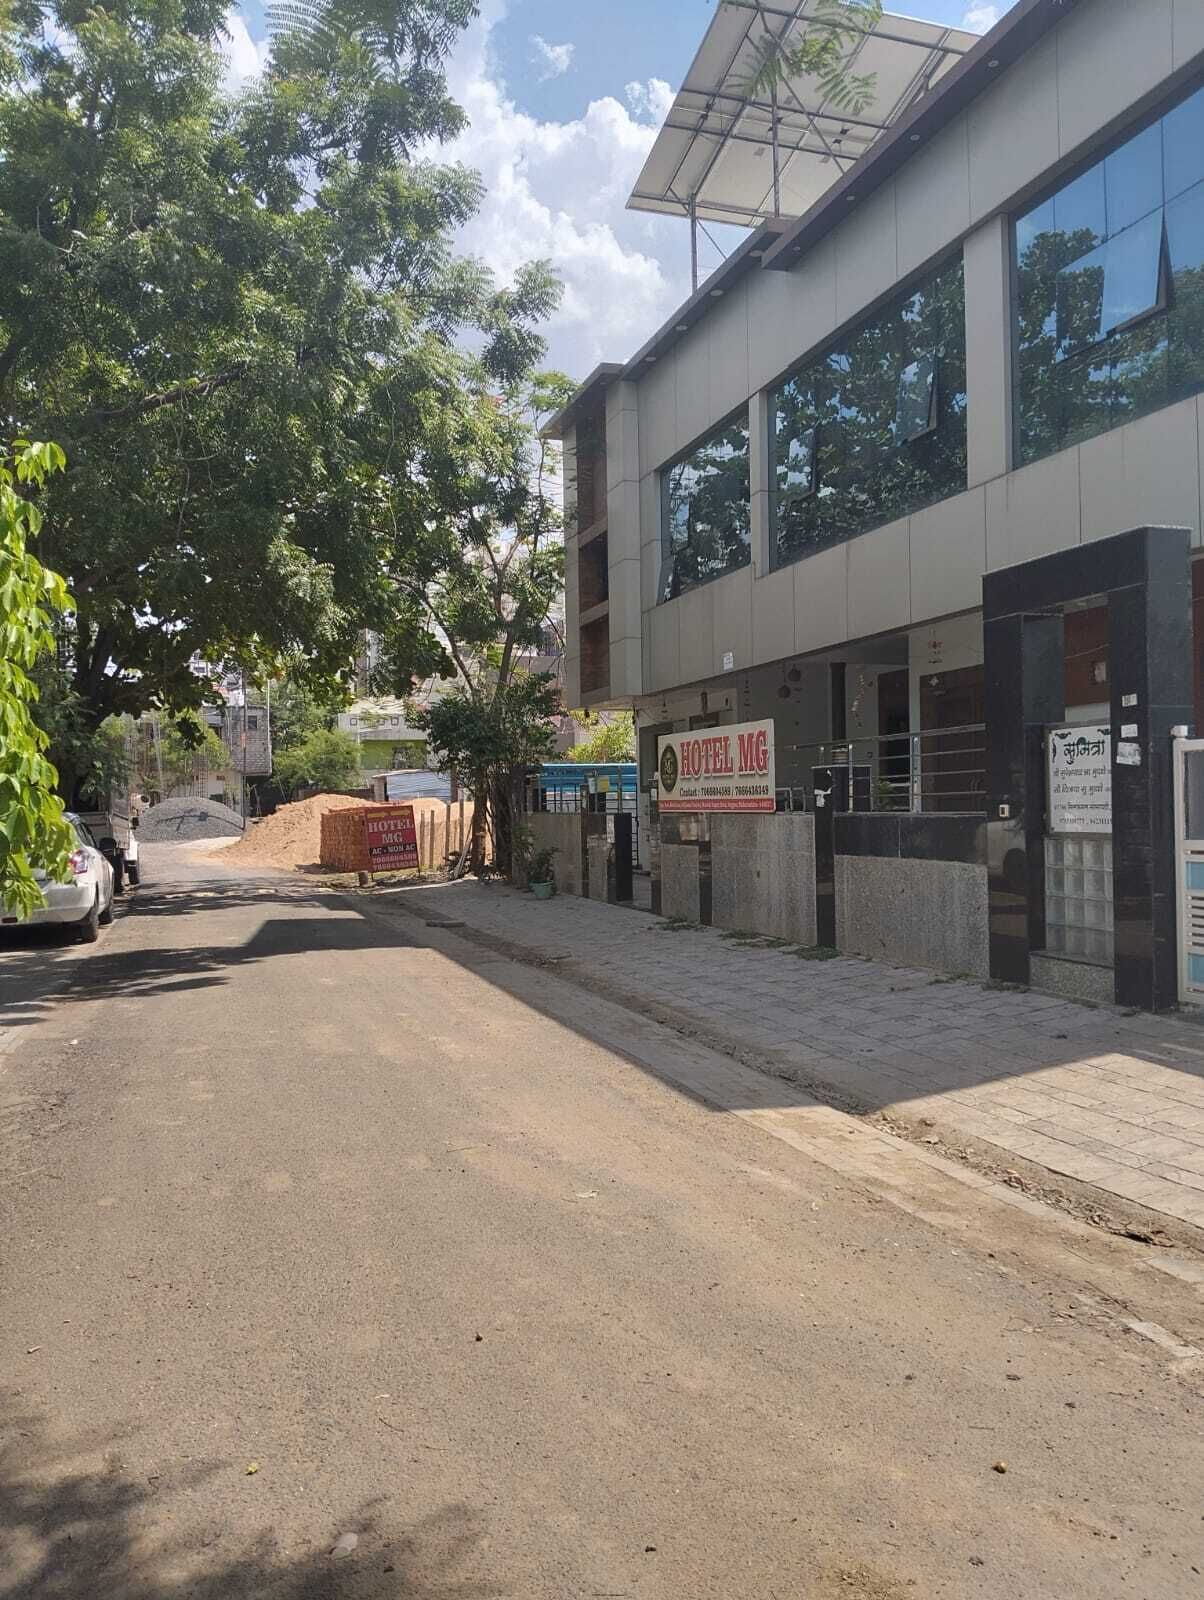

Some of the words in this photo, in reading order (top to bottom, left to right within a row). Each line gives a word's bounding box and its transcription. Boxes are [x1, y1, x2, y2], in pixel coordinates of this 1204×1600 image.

[680, 735, 734, 778] HOTEL
[738, 730, 769, 775] MG
[680, 788, 697, 797] Contact
[368, 818, 414, 833] HOTEL
[382, 831, 402, 844] MG
[373, 847, 382, 855] AC
[388, 845, 404, 853] NON
[406, 843, 416, 851] AC
